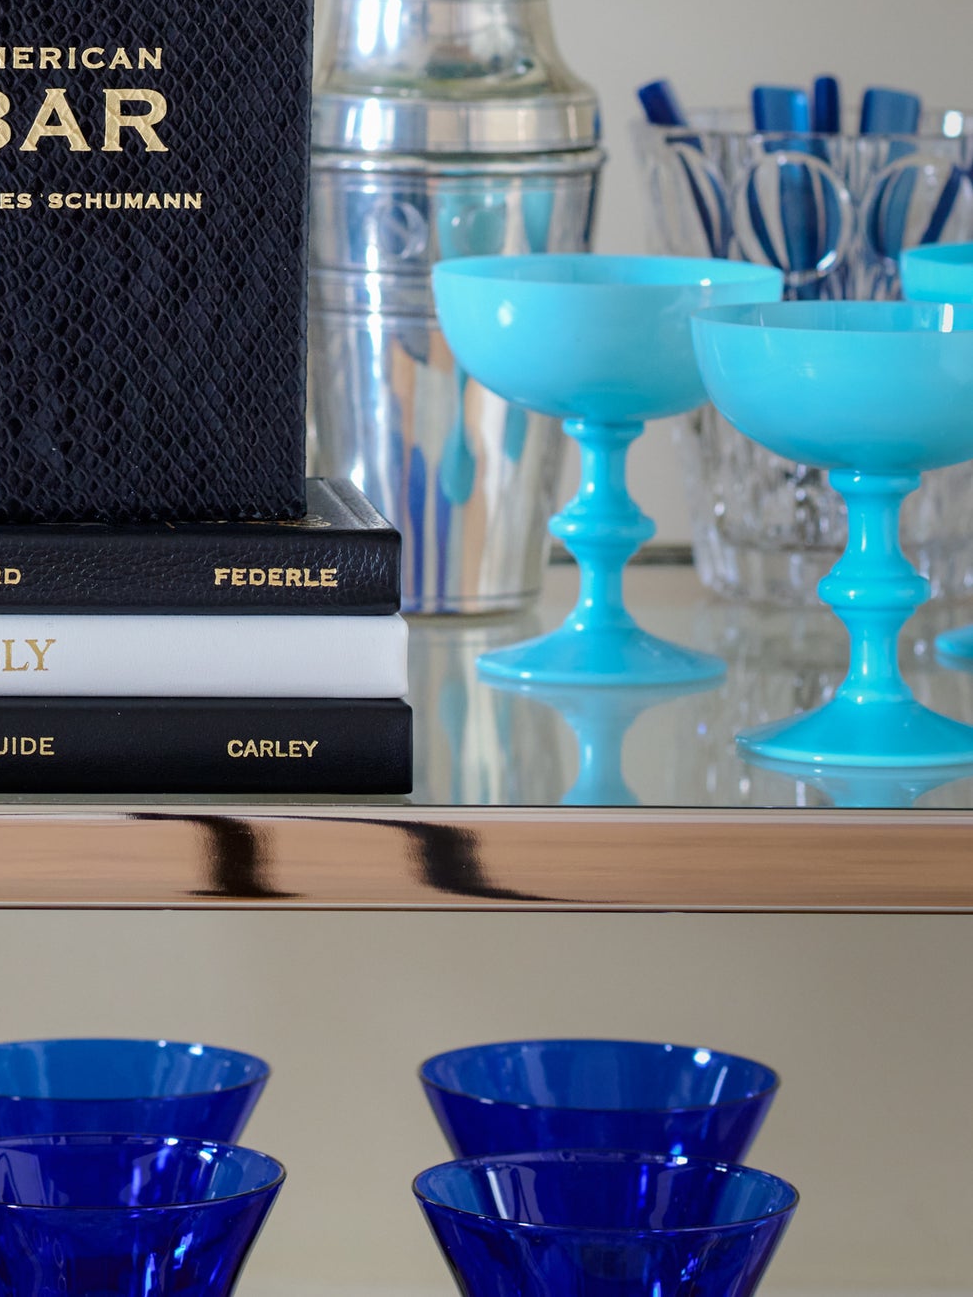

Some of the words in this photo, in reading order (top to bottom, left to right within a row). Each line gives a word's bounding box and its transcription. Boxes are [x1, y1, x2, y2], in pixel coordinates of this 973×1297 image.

[48, 192, 203, 210] SCHUMANN
[214, 567, 339, 588] FEDERLE
[226, 739, 319, 758] CARLEY
